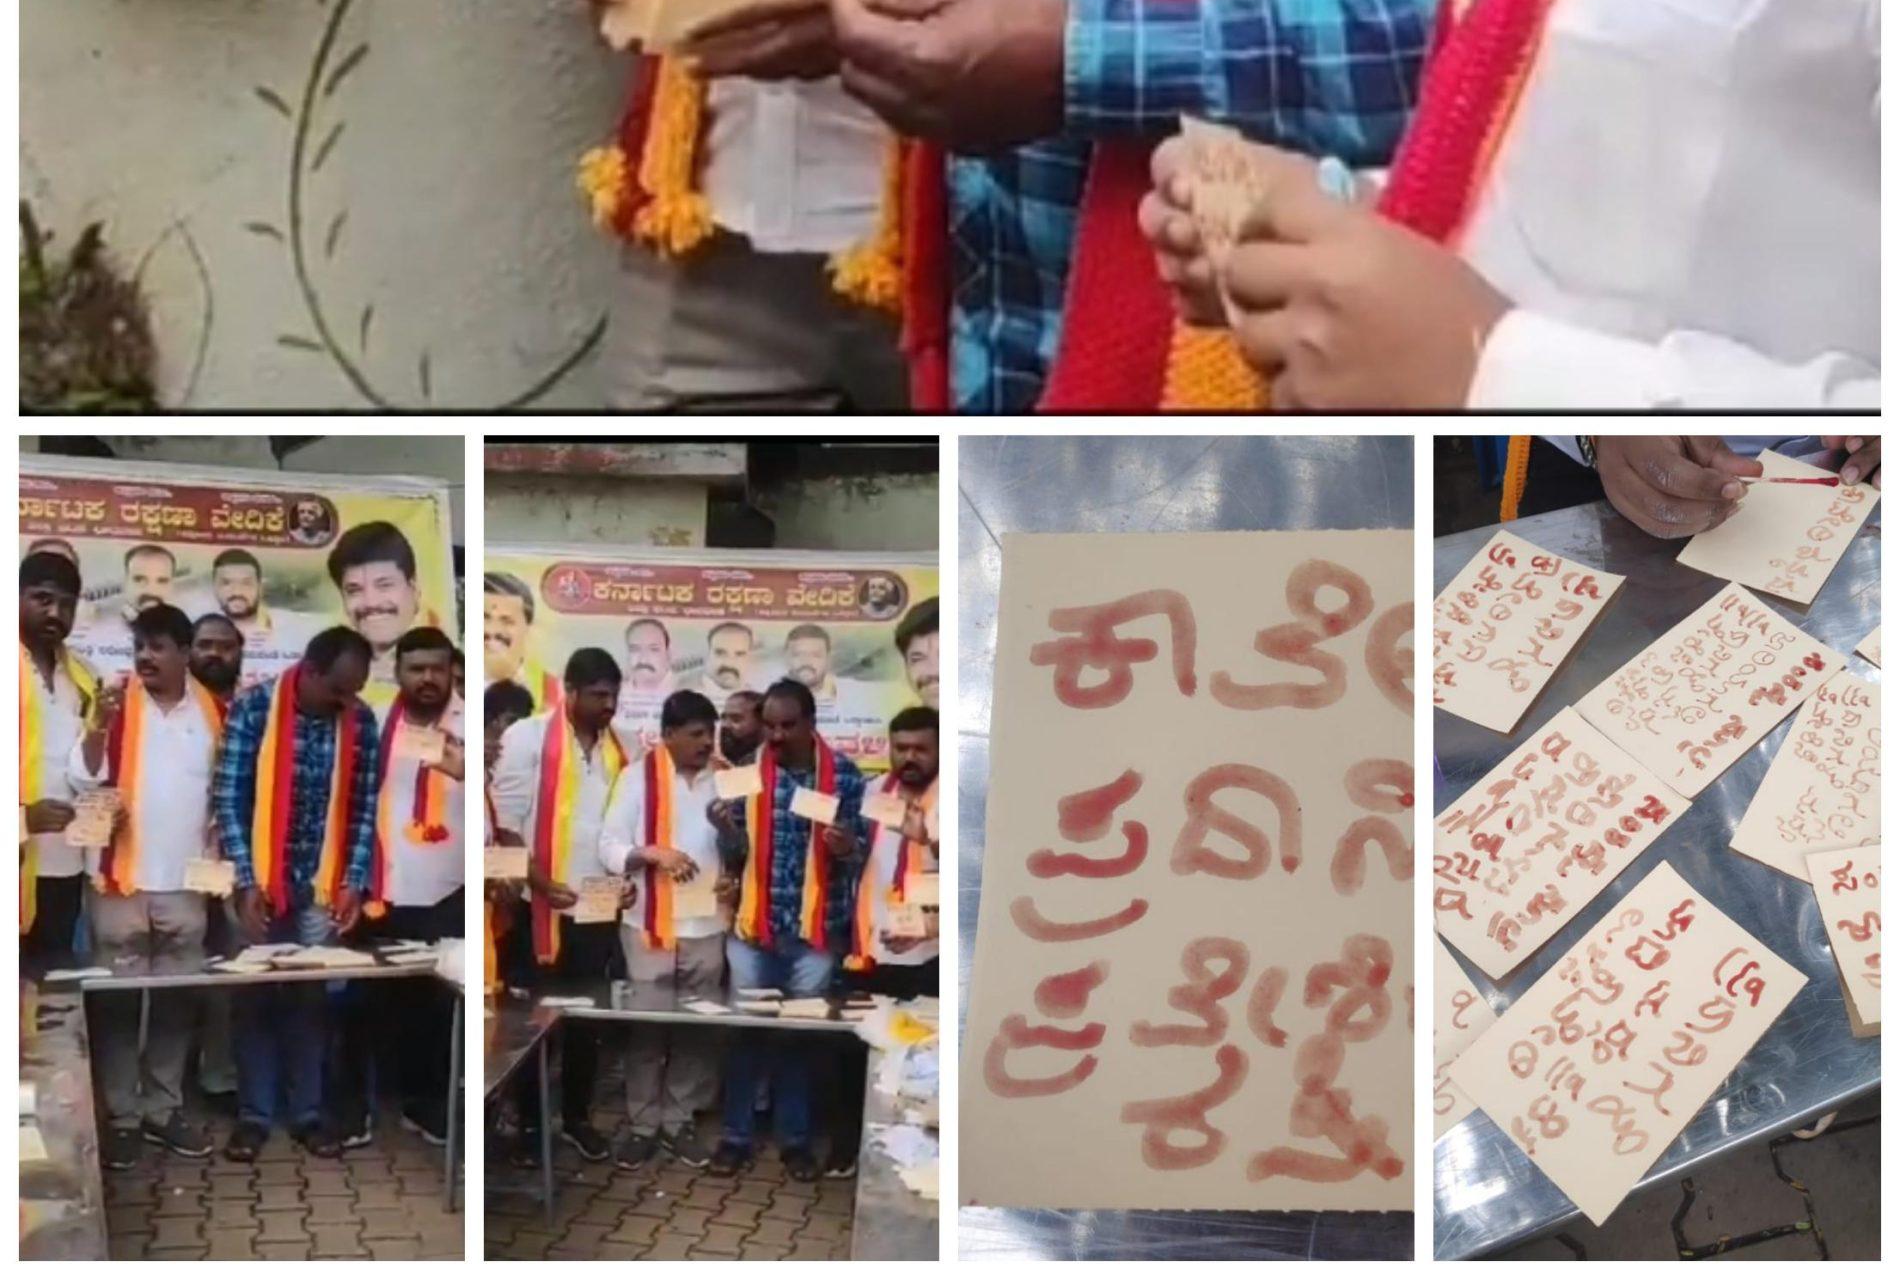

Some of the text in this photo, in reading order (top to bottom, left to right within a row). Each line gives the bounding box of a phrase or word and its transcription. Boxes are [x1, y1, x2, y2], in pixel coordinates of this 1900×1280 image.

[120, 502, 198, 536] ರಕ್ಷಣಾ
[211, 505, 287, 533] ವೇದಿಕೆ
[593, 579, 696, 603] ಕರ್ನಾಟಕ
[707, 583, 775, 612] ರಕ್ಷಣಾ
[787, 583, 857, 609] ವೇದಿಕೆ
